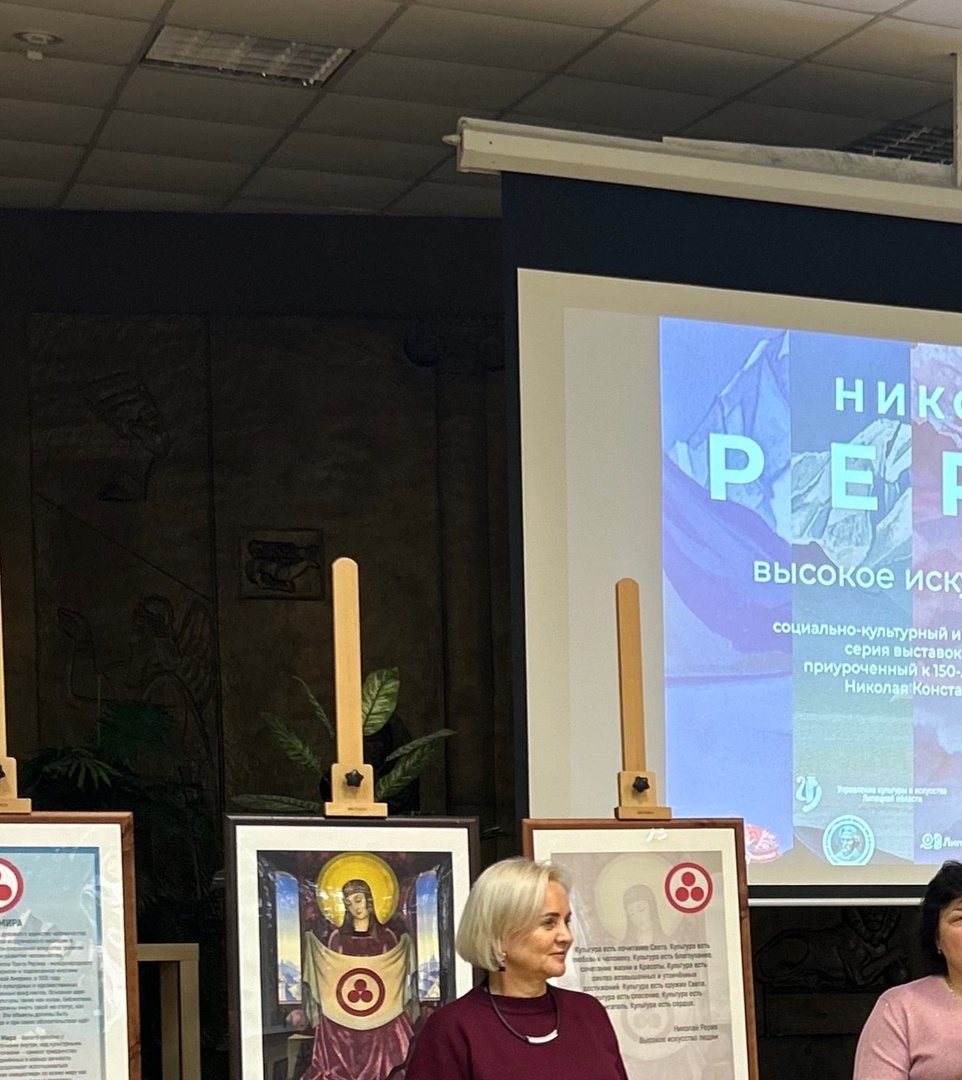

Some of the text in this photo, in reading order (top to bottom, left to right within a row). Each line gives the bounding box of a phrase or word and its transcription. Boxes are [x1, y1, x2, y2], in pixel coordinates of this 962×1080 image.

[772, 621, 948, 642] социально-культурный
[952, 630, 961, 640] и
[845, 643, 889, 658] серия
[894, 645, 962, 660] выставок
[804, 661, 917, 677] приуроченный
[922, 666, 930, 677] к
[845, 679, 909, 695] Николая
